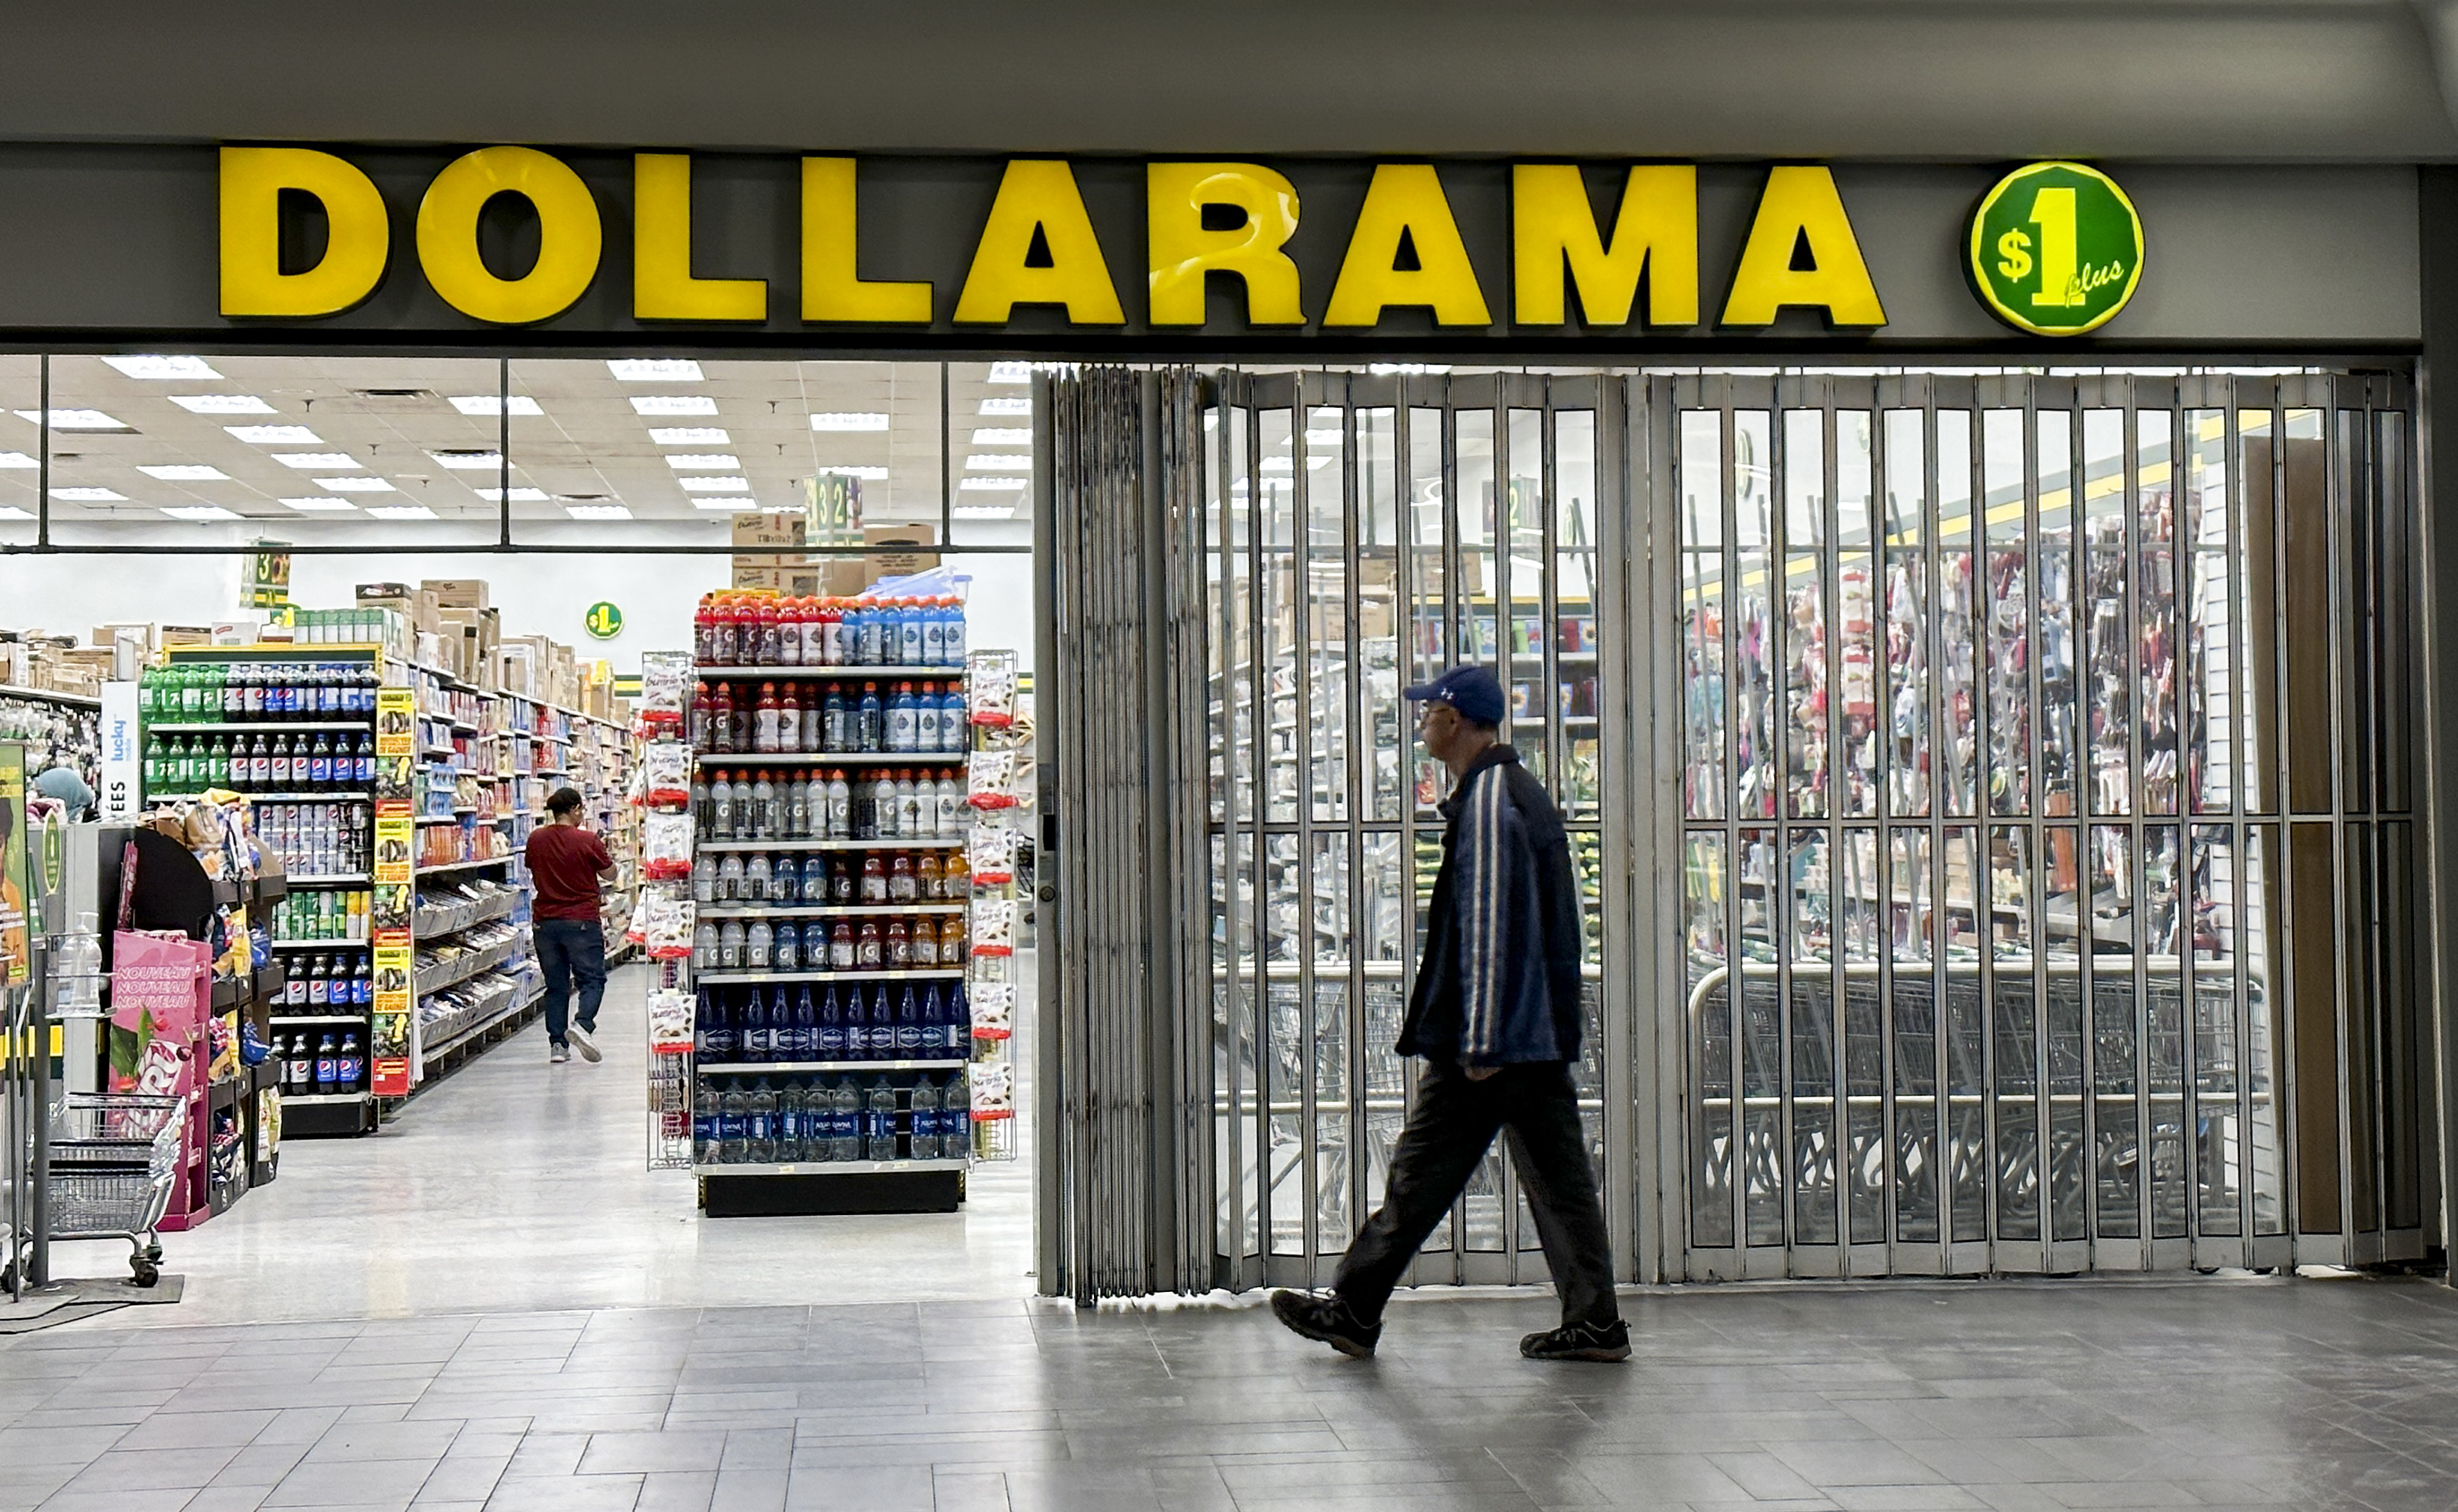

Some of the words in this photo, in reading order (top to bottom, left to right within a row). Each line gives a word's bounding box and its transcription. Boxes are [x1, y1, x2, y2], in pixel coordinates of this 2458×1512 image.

[219, 145, 1887, 326] DOLLARAMA
[2063, 260, 2124, 308] plus
[819, 483, 827, 525] 3
[834, 483, 844, 524] 2
[111, 720, 127, 762] lucky
[105, 782, 125, 817] ÉES
[116, 966, 191, 980] NOUVEAU
[116, 981, 190, 994] NOUVEAU
[115, 995, 190, 1008] NOUVEAU
